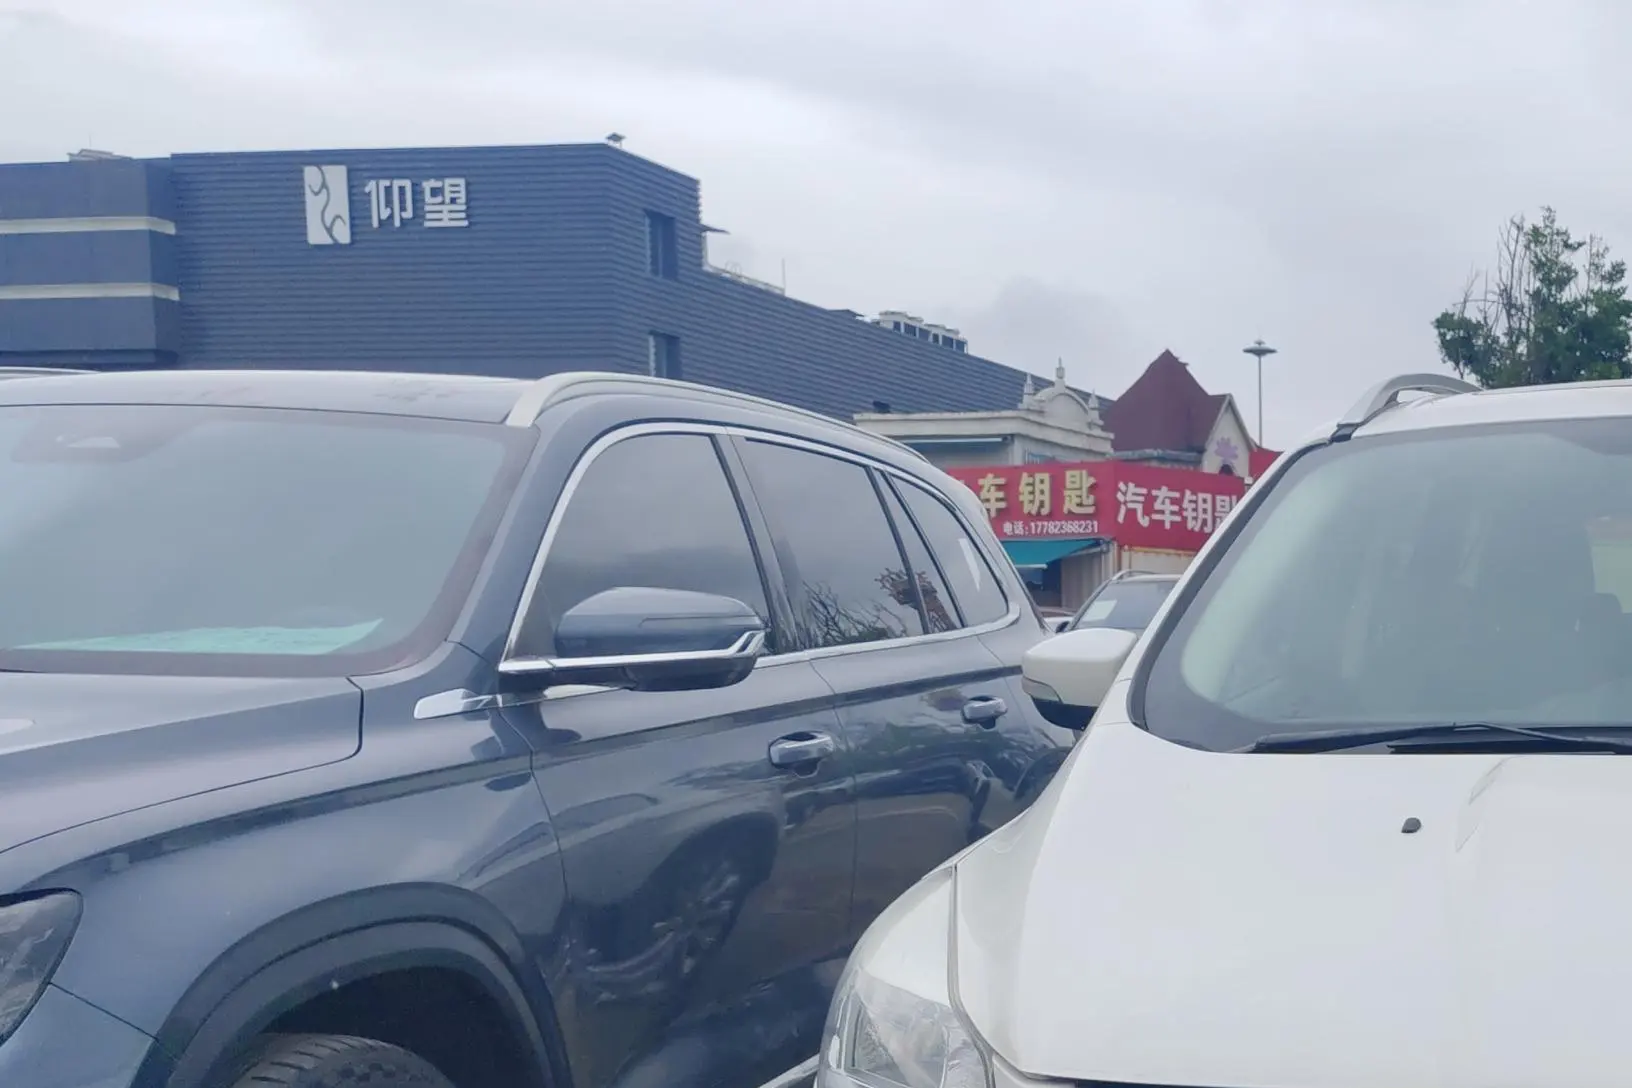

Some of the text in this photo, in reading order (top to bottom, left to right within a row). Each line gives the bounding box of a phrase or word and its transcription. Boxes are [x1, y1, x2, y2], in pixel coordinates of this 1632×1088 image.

[364, 178, 469, 229] 仰望
[954, 469, 1097, 518] 车钥匙
